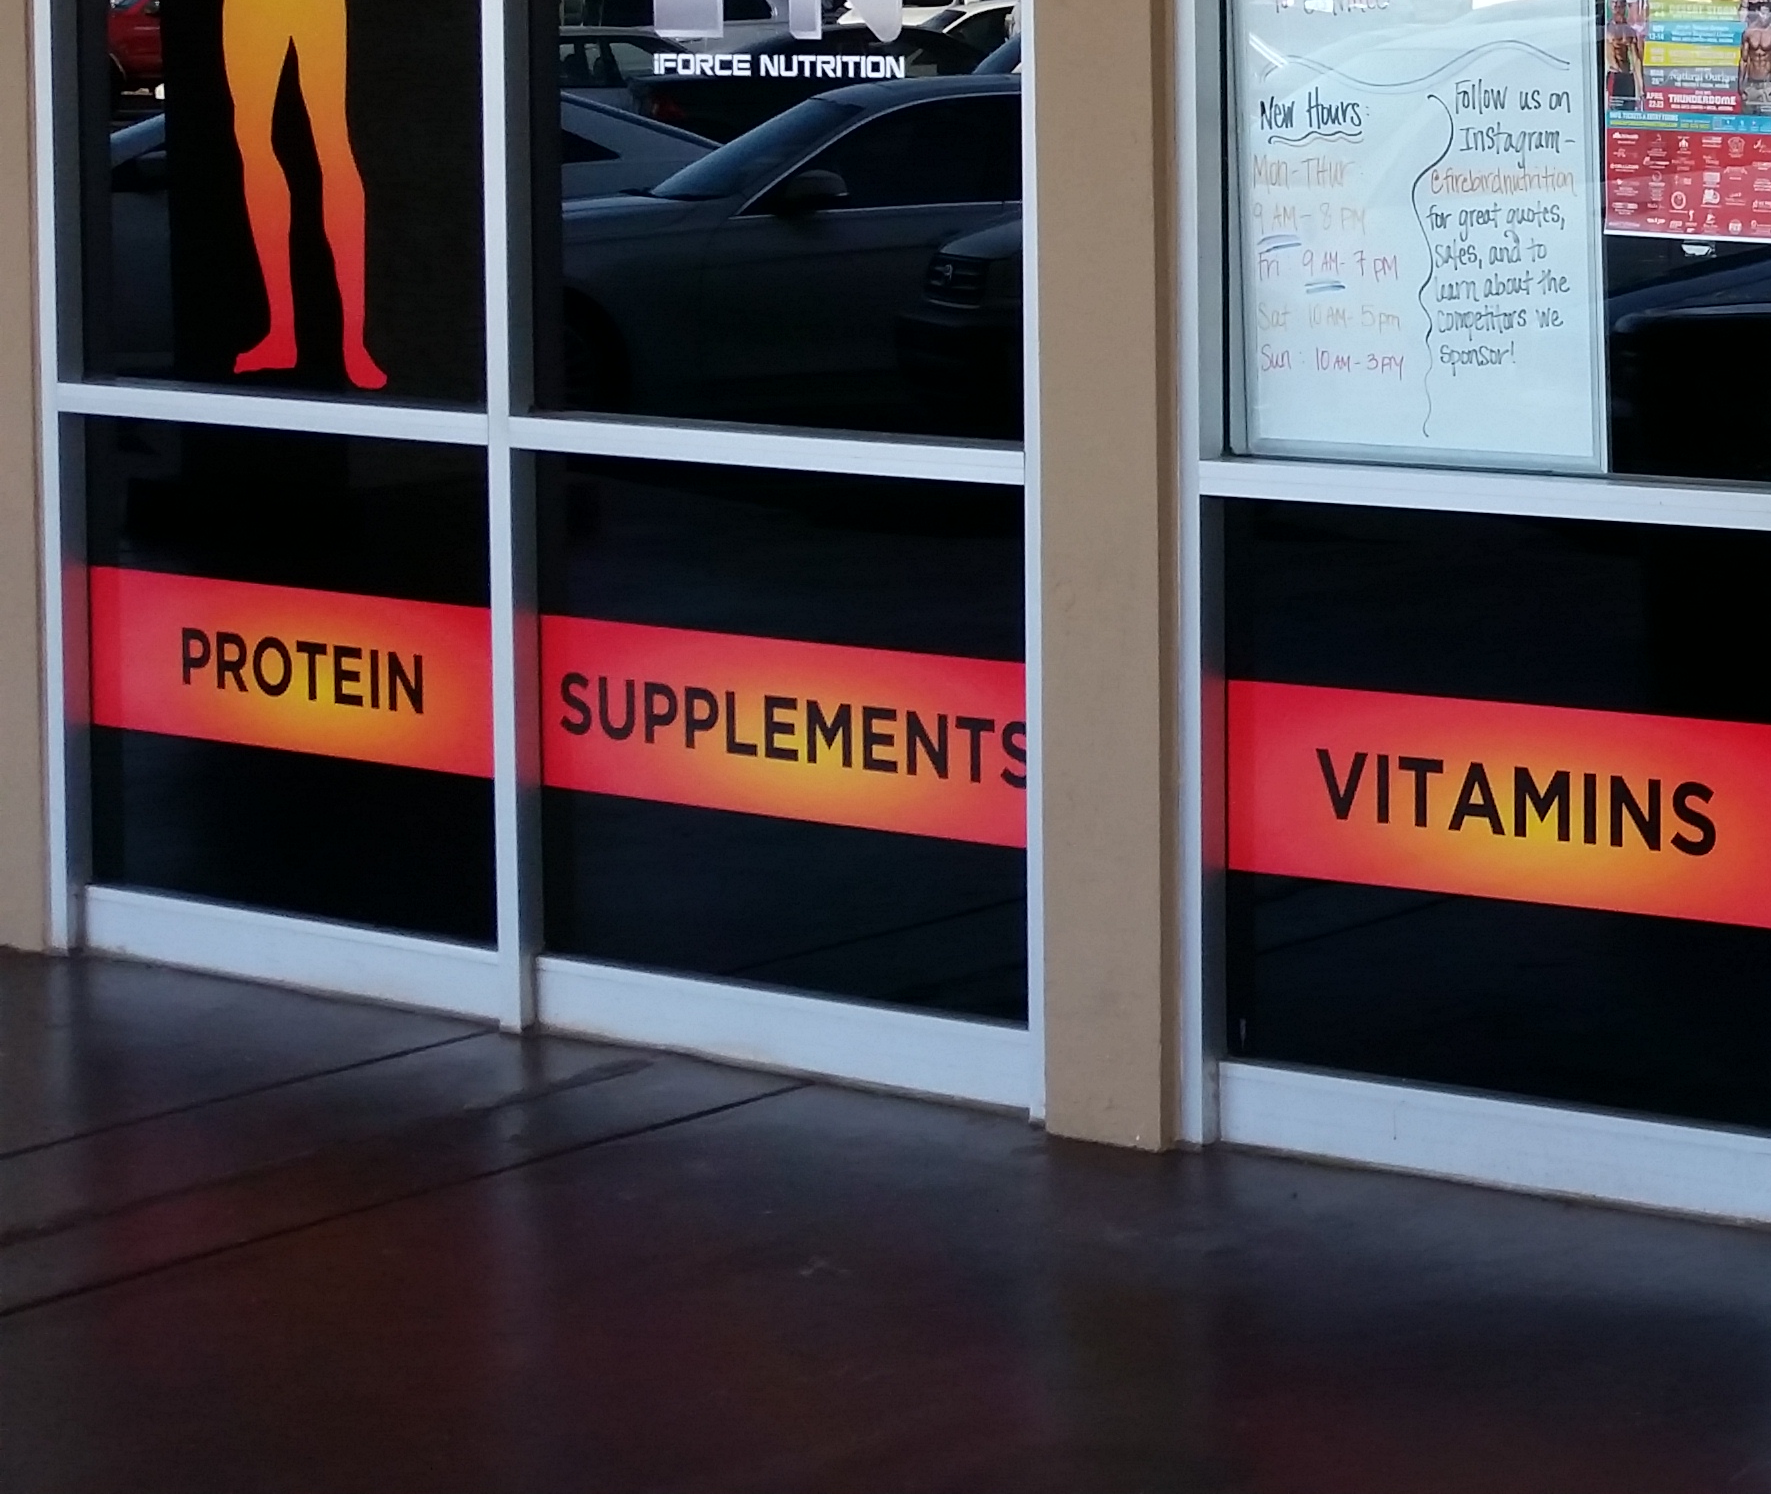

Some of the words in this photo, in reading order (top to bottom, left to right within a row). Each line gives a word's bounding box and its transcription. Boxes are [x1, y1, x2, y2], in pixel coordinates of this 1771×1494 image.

[760, 55, 905, 78] NUTRITION
[1260, 96, 1295, 130] New
[1454, 79, 1508, 115] Follow
[1518, 88, 1541, 112] us
[1549, 90, 1572, 114] on
[1426, 204, 1452, 231] for
[1458, 202, 1502, 242] great
[1488, 234, 1521, 263] and
[1526, 238, 1548, 263] to
[1483, 272, 1534, 303] about
[1537, 268, 1571, 295] the
[1437, 304, 1527, 342] competitors
[1535, 307, 1564, 329] we
[180, 627, 425, 714] PROTEIN
[1316, 748, 1716, 856] VITAMINS
